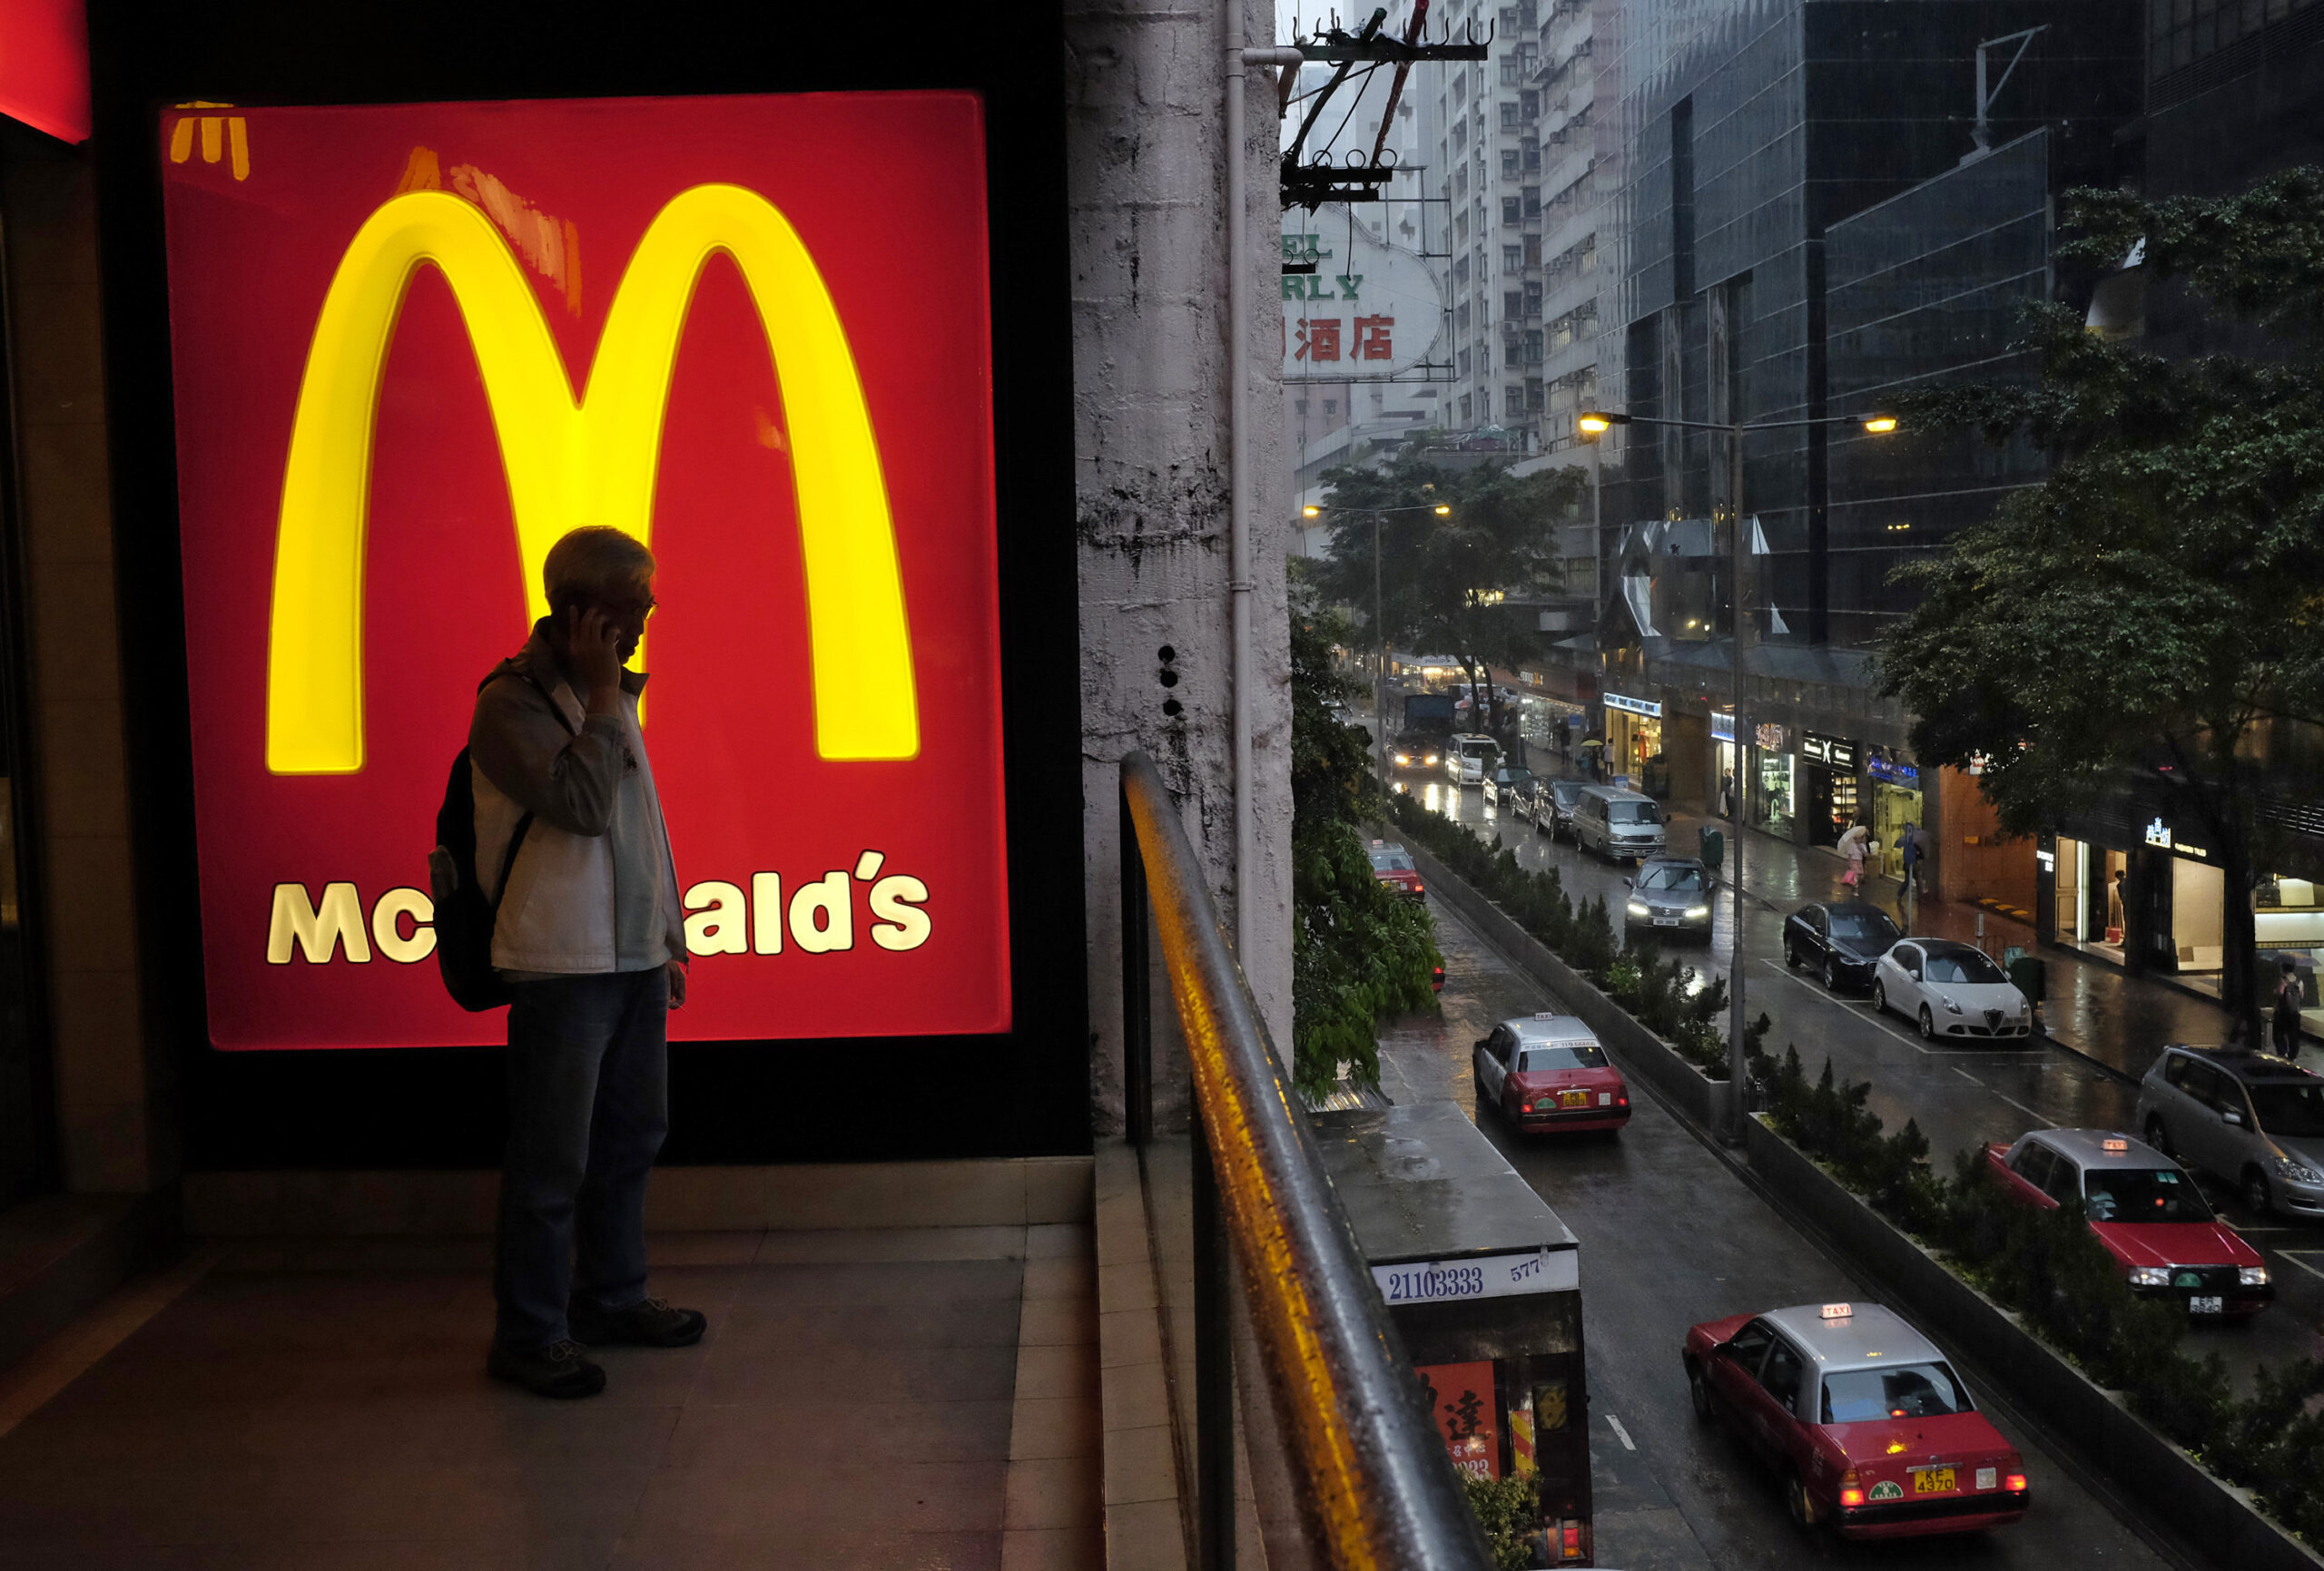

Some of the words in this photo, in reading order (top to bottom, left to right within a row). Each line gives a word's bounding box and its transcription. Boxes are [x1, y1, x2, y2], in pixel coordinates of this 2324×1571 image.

[1282, 314, 1394, 361] 酒店
[266, 848, 932, 965] Mcald's
[1389, 1267, 1484, 1301] 21103333
[1511, 1259, 1541, 1282] 577
[1826, 1307, 1849, 1316] TAXI
[1917, 1478, 1954, 1492] 4370
[1925, 1468, 1945, 1481] KF
